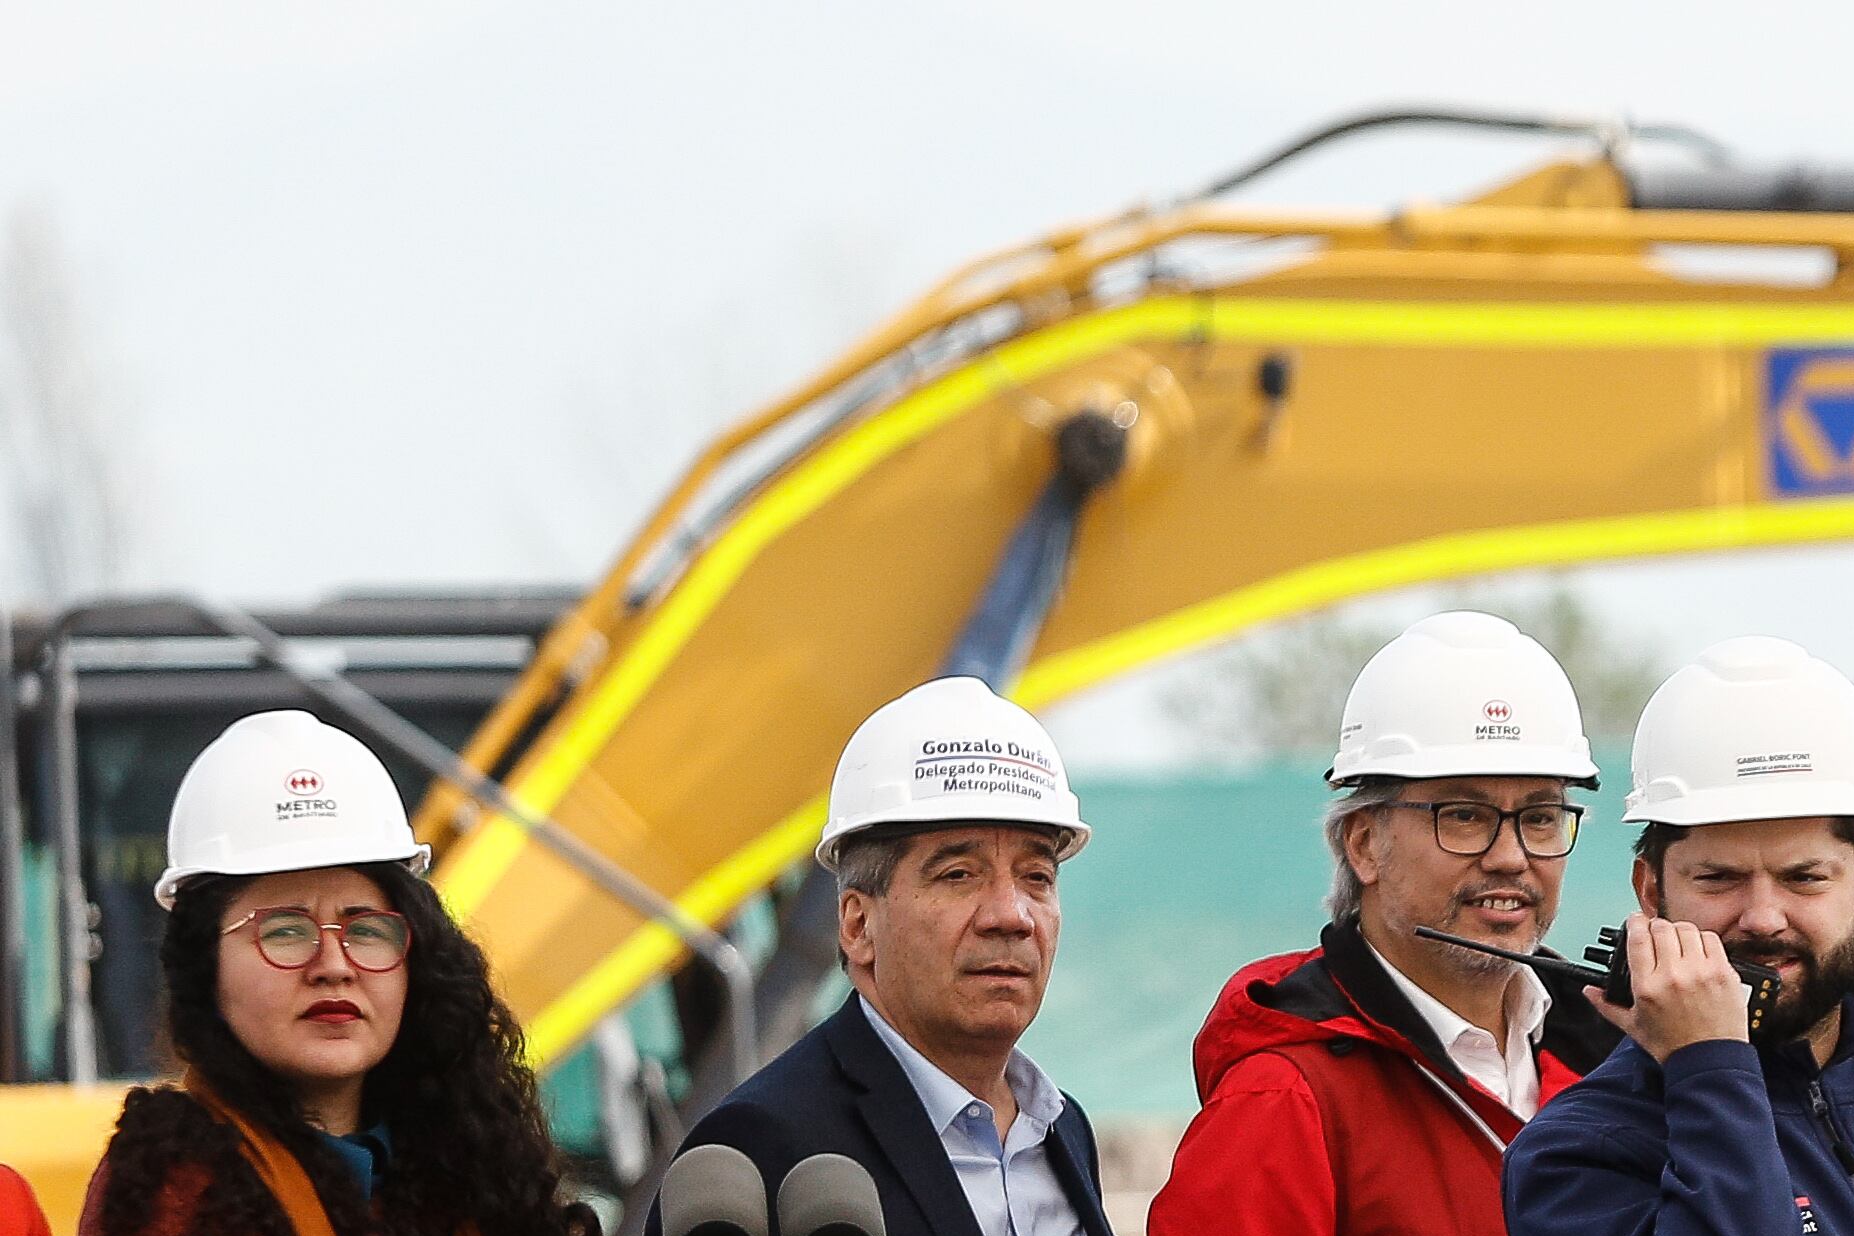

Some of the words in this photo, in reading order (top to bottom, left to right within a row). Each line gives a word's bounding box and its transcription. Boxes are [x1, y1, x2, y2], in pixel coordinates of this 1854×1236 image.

[1475, 725, 1521, 735] METRO
[922, 738, 1002, 755] Gonzalo
[1007, 741, 1051, 768] Durán
[915, 762, 985, 779] Delegado
[943, 778, 1042, 799] Metropolitano
[276, 799, 337, 812] METRO
